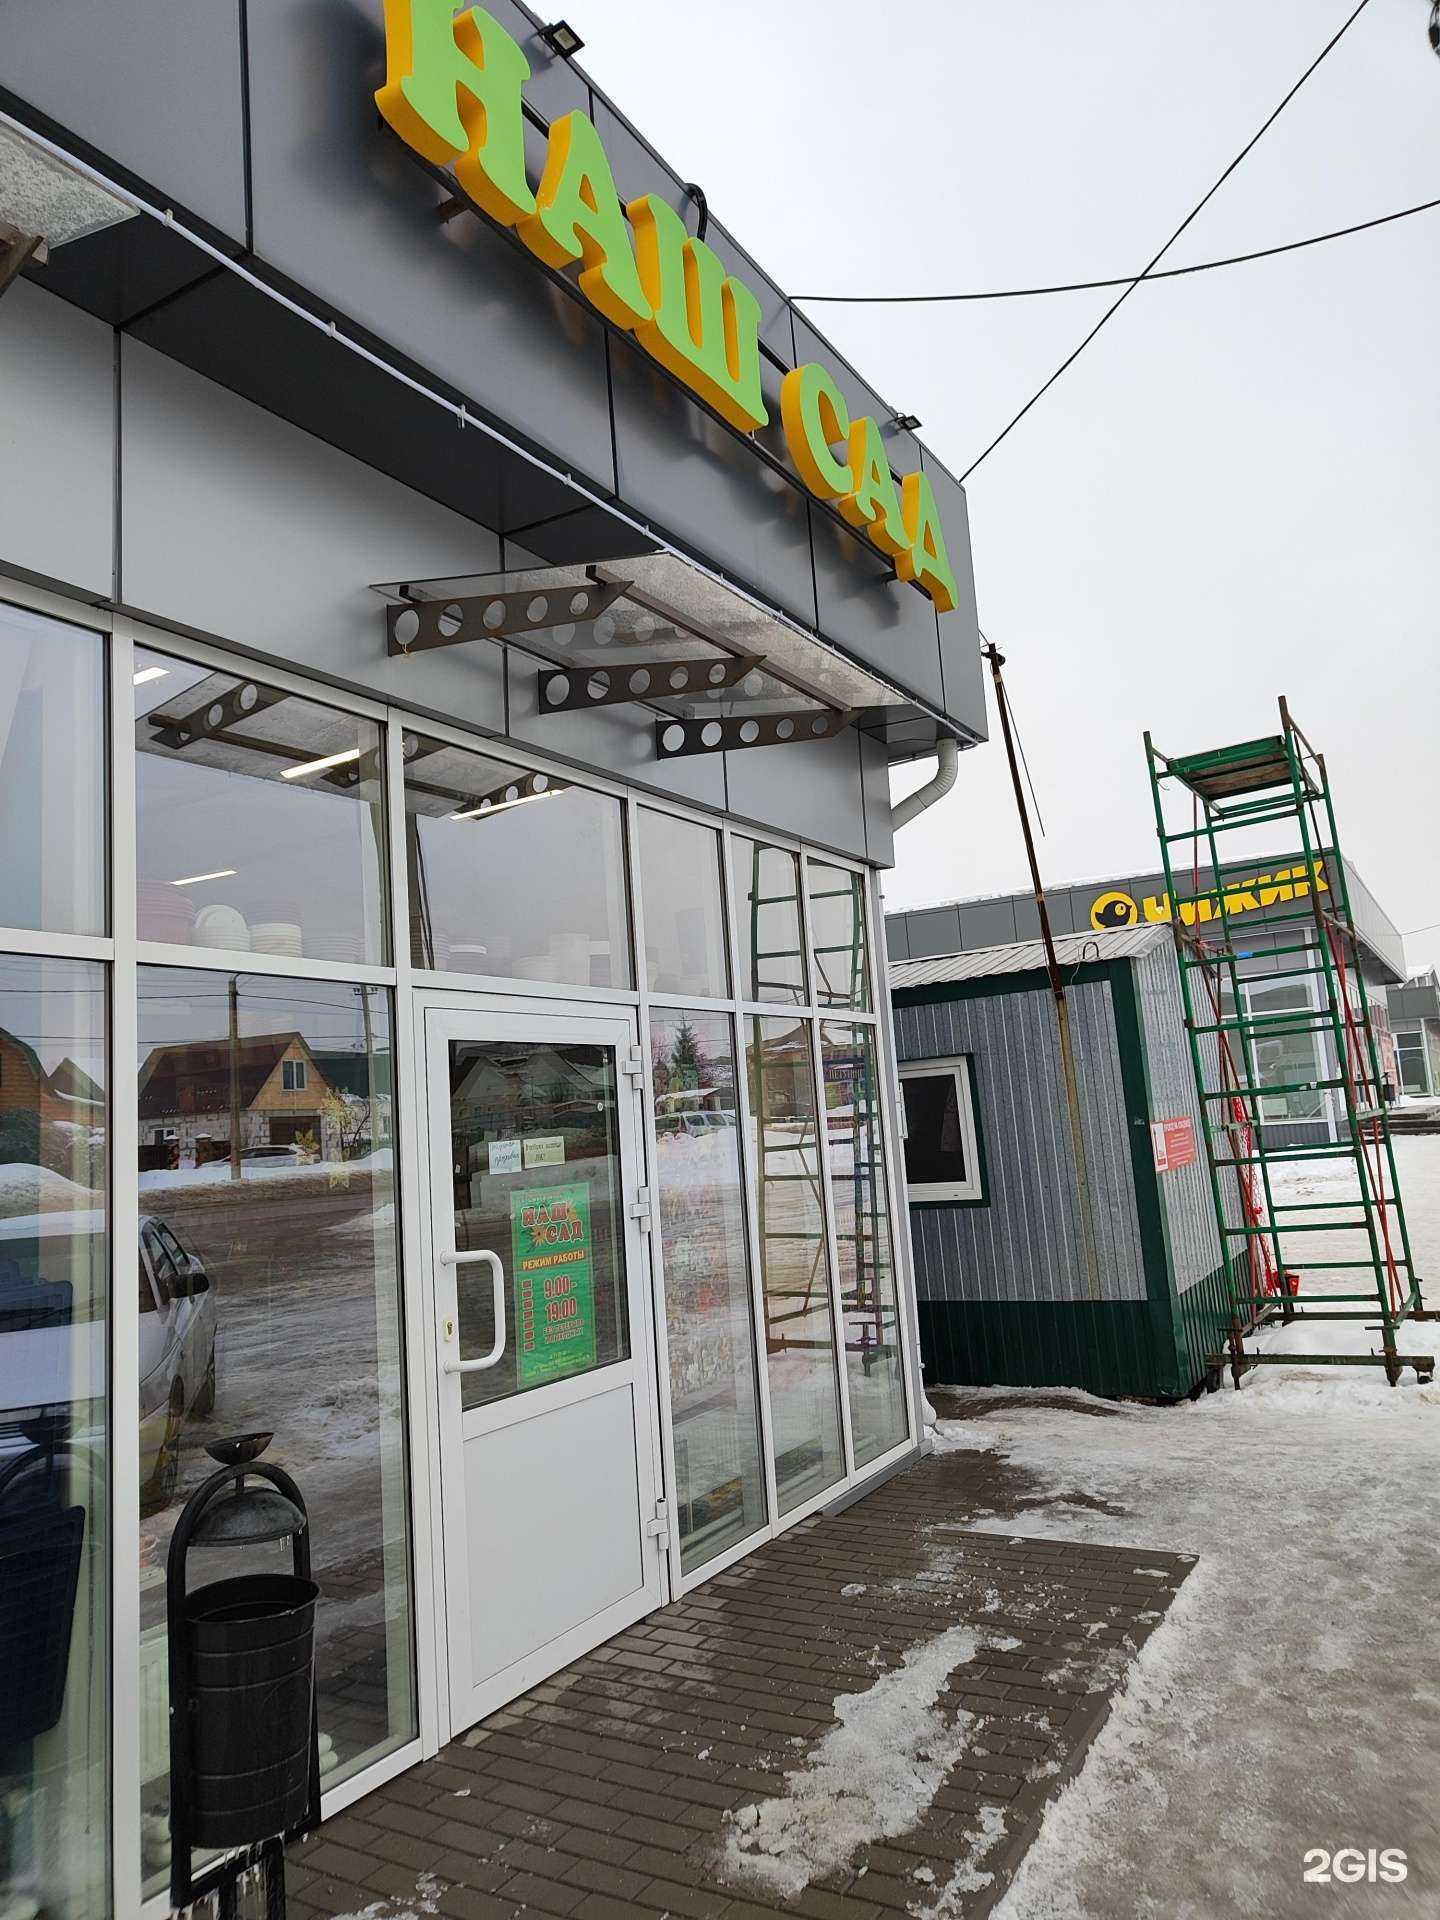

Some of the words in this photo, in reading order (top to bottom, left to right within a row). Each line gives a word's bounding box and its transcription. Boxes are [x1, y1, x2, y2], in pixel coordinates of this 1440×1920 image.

[374, 0, 769, 432] НАШ
[780, 362, 958, 612] САД
[521, 1201, 568, 1228] НАШ
[553, 1249, 585, 1265] РАБОТЫ
